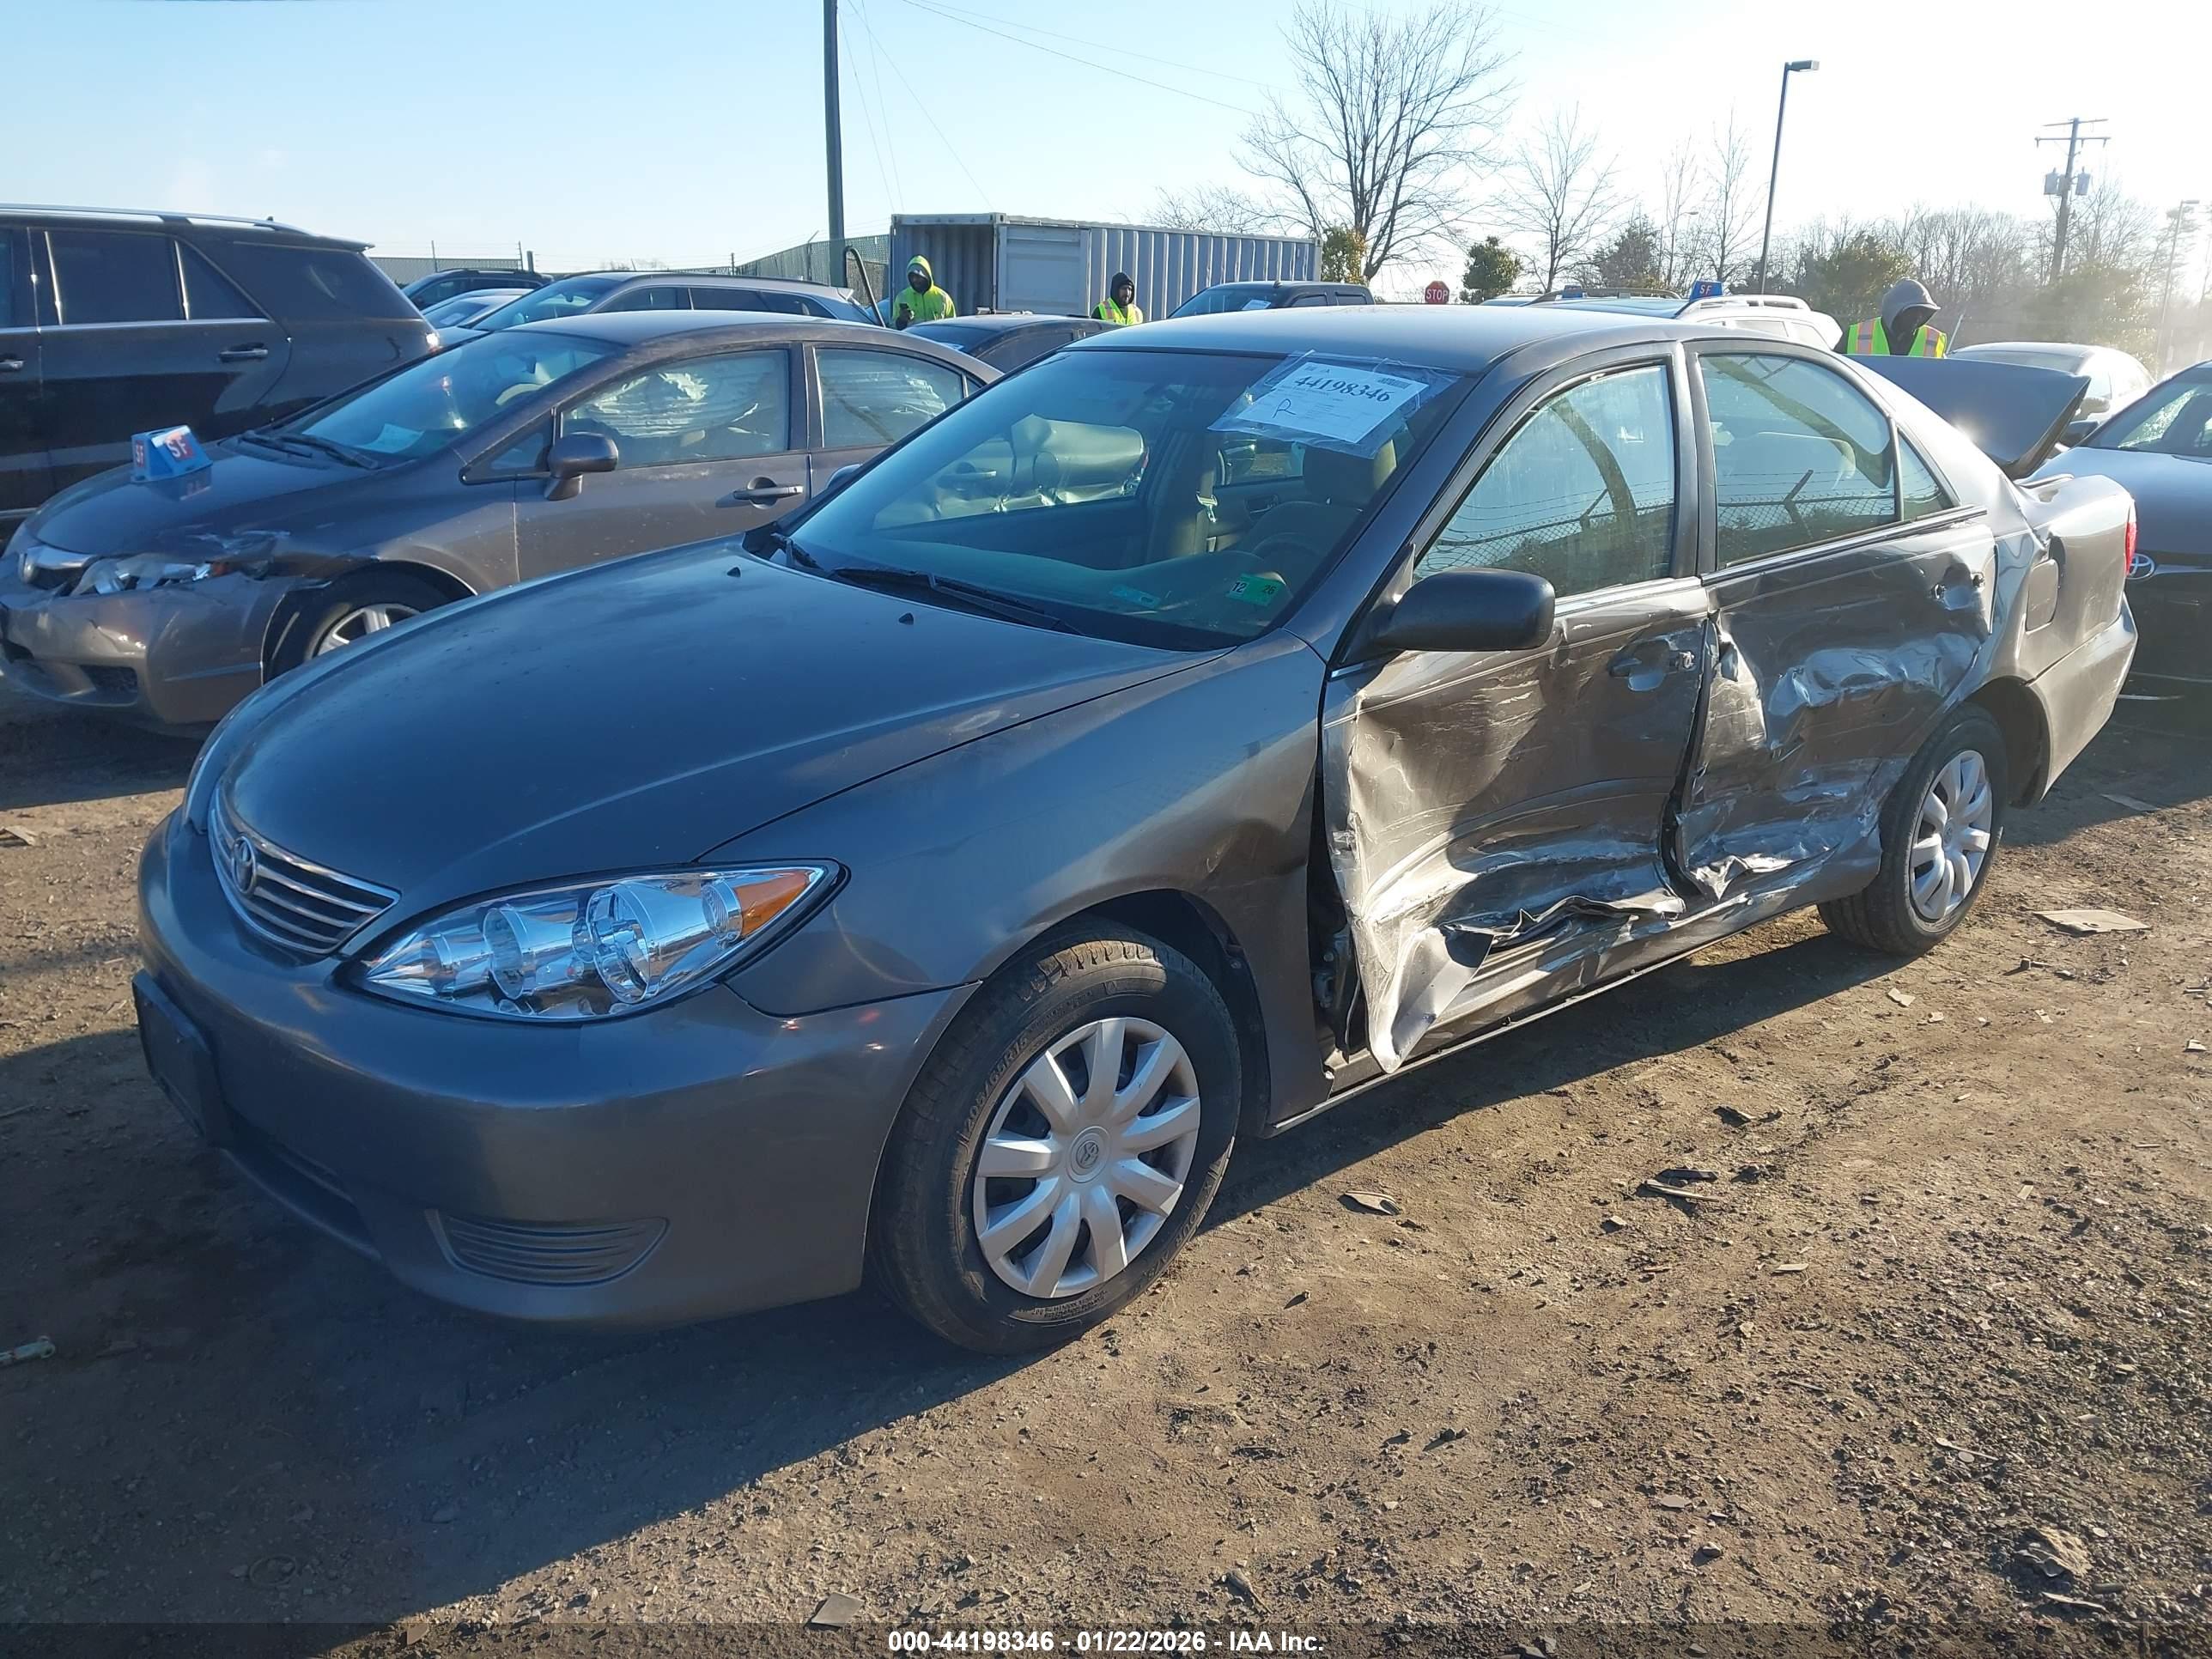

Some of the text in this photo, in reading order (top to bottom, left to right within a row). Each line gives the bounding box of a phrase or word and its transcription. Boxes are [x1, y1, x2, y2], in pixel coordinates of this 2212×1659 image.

[1425, 289, 1449, 301] STOP
[1699, 284, 1712, 296] SF
[1294, 375, 1395, 403] 44198346
[1231, 581, 1247, 593] 12
